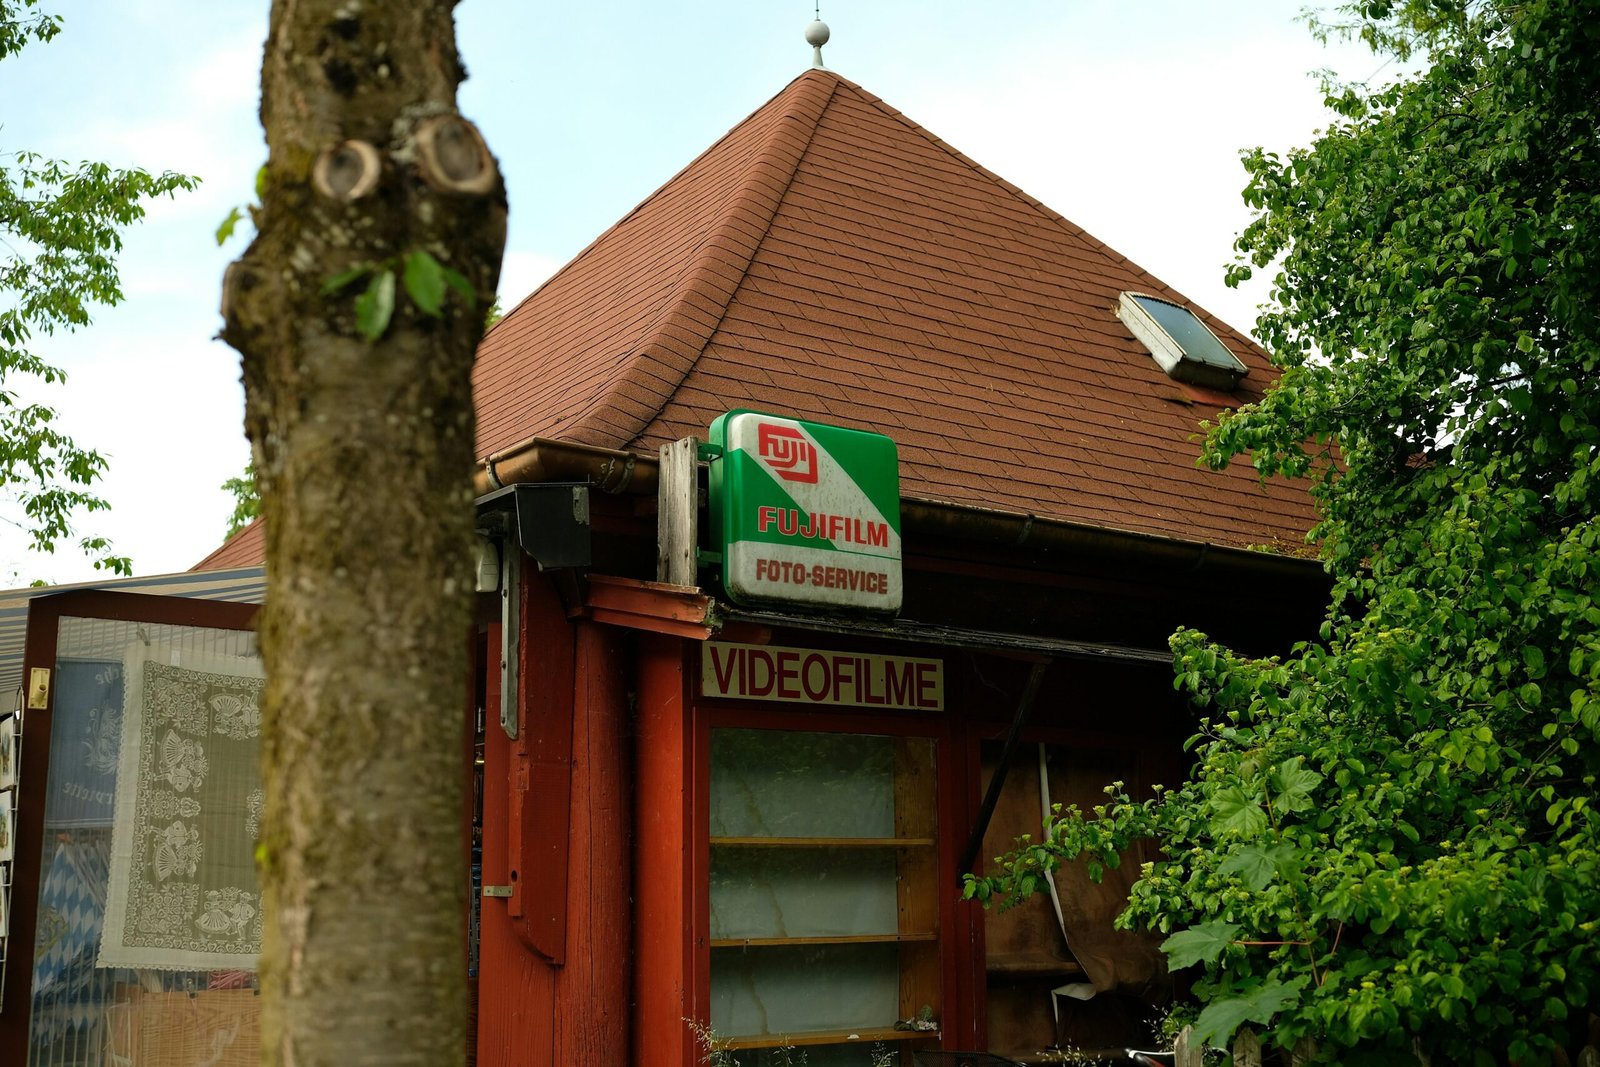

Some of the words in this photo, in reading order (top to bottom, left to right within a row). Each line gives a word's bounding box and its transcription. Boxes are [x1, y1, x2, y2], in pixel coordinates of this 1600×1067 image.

[758, 423, 818, 484] FUJI
[758, 506, 888, 548] FUJIFILM
[756, 558, 888, 595] FOTO-SERVICE
[709, 646, 939, 708] VIDEOFILME
